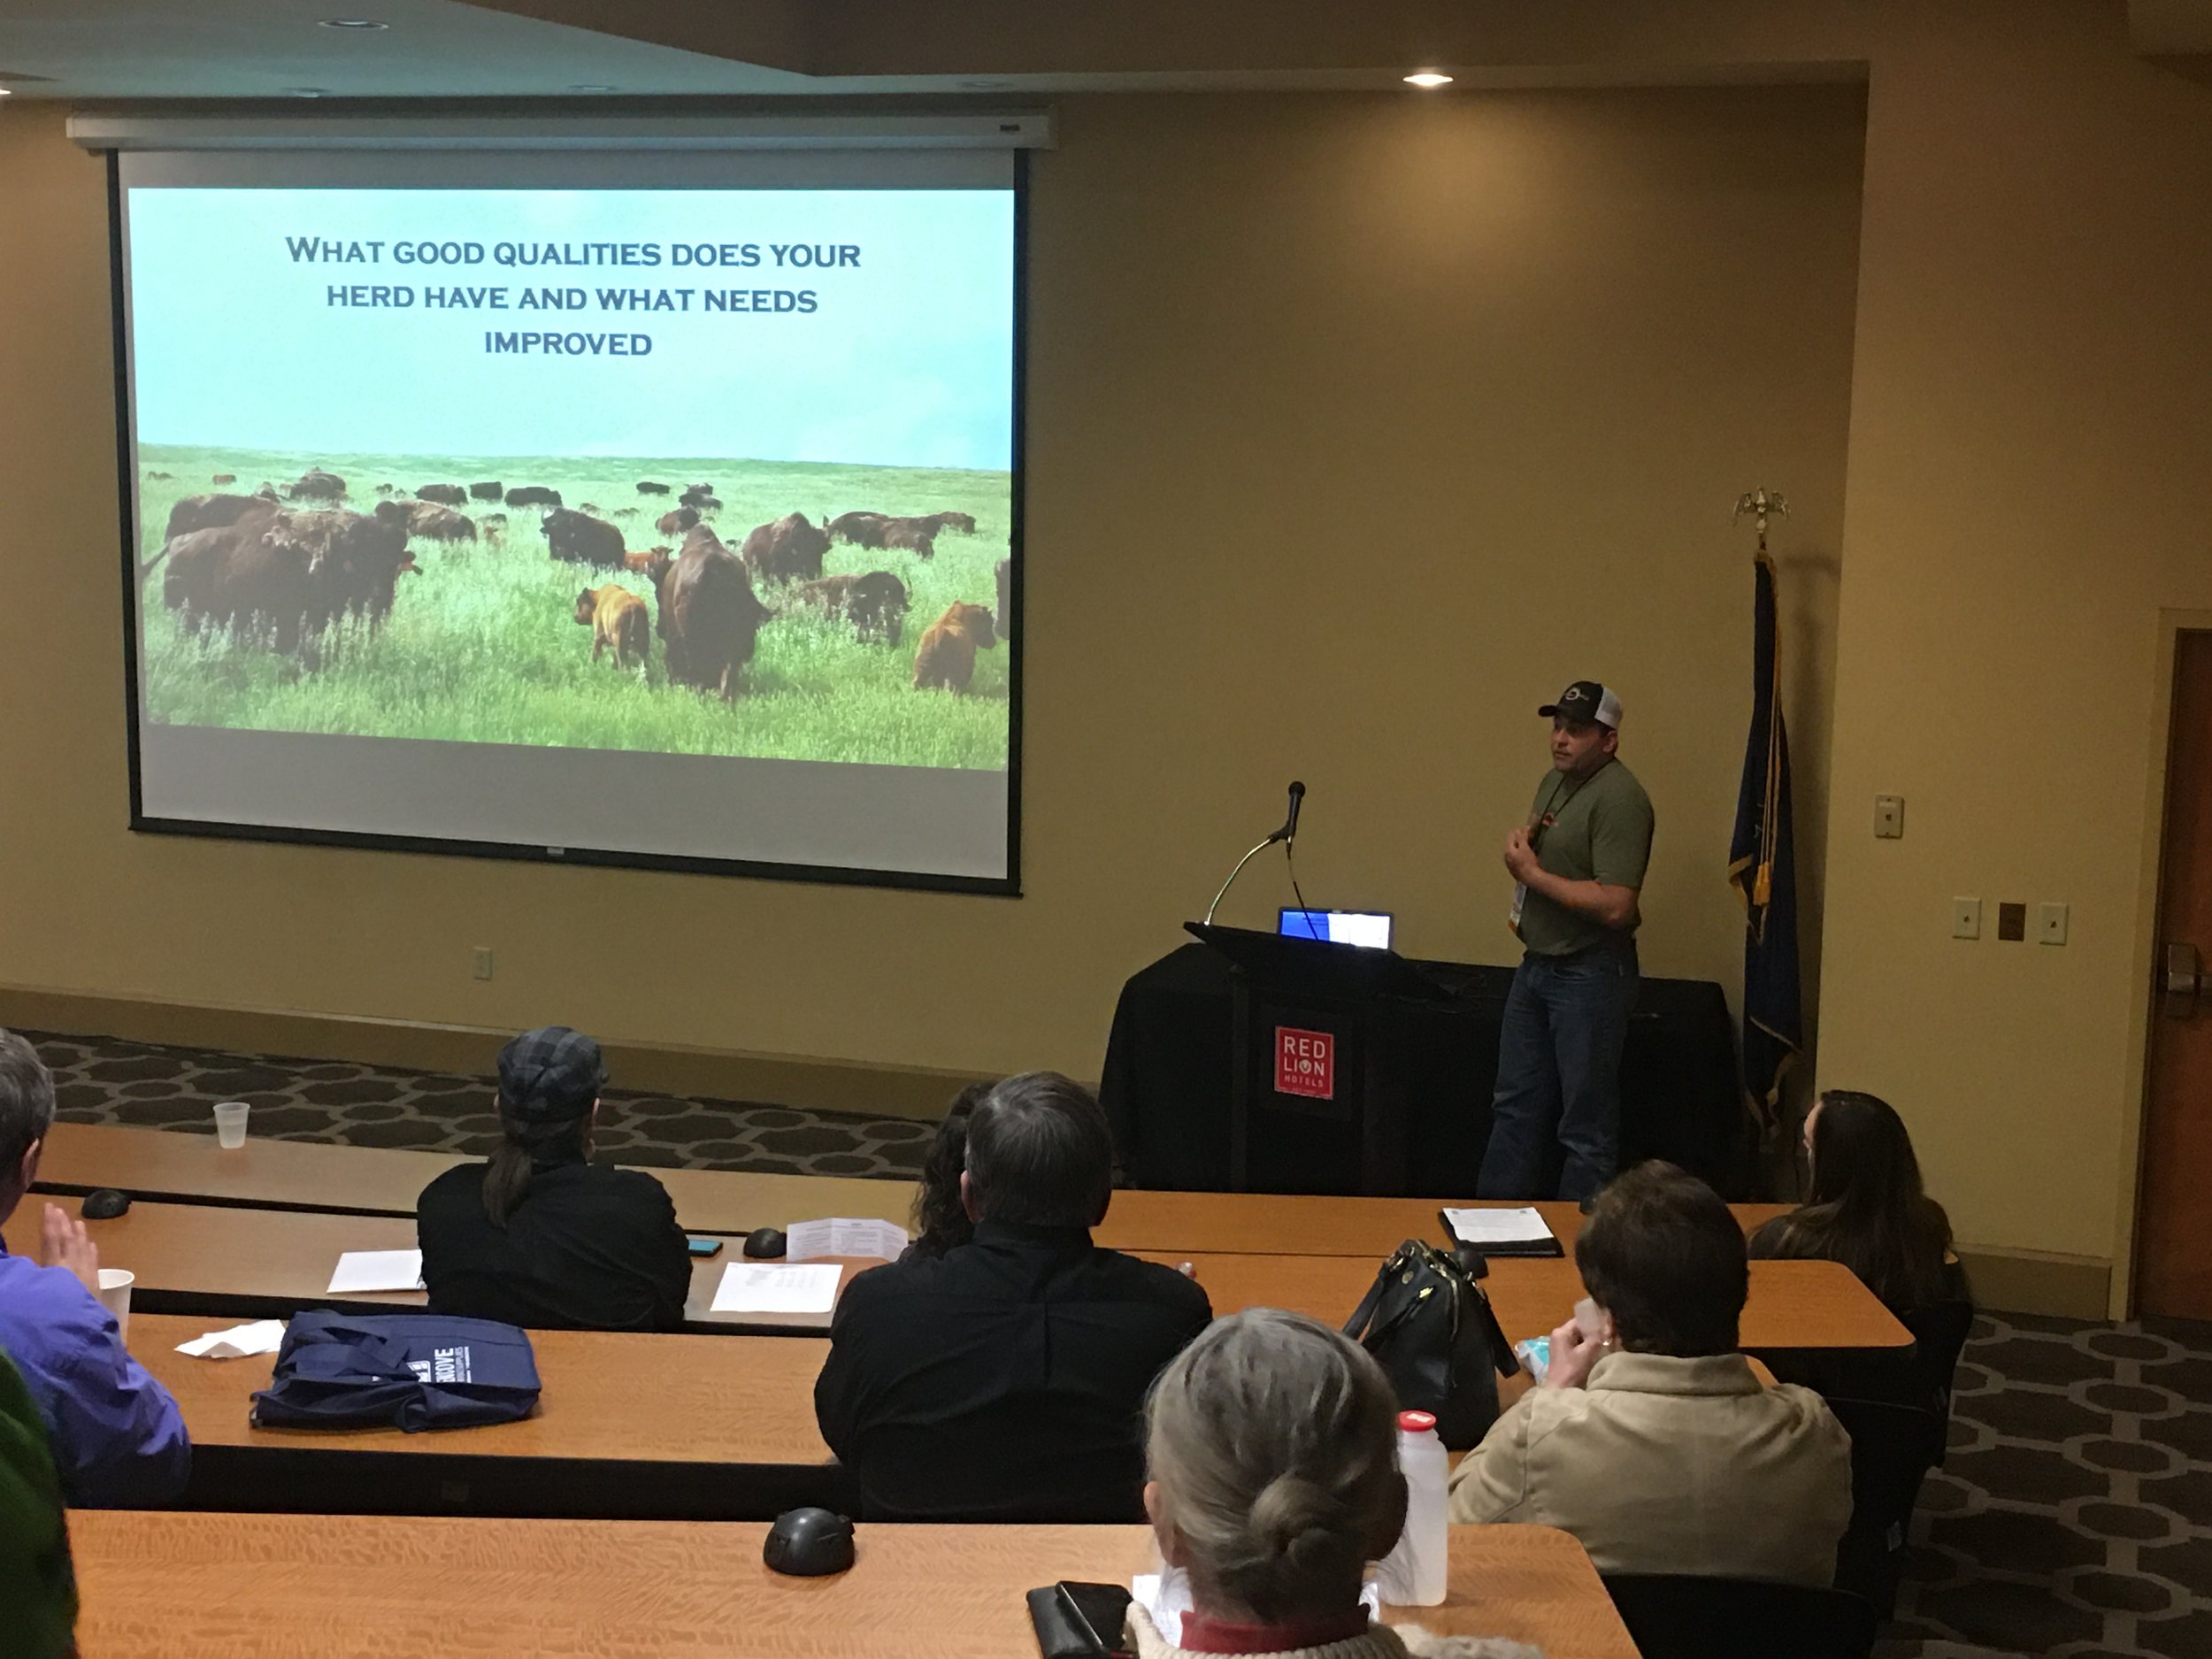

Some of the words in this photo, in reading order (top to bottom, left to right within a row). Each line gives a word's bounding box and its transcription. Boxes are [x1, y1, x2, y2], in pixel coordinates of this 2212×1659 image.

[393, 242, 485, 265] GOOD
[493, 242, 663, 268] QUALITIES
[671, 242, 762, 268] DOES
[768, 243, 862, 269] YOUR
[326, 285, 416, 308] HERD
[424, 286, 510, 311] HAVE
[517, 287, 588, 311] AND
[594, 288, 696, 312] WHAT
[703, 288, 819, 314] NEEDS
[484, 331, 653, 356] IMPROVED
[1284, 1035, 1325, 1059] RED
[1284, 1056, 1325, 1076] LION
[1284, 1074, 1324, 1087] HOTELS
